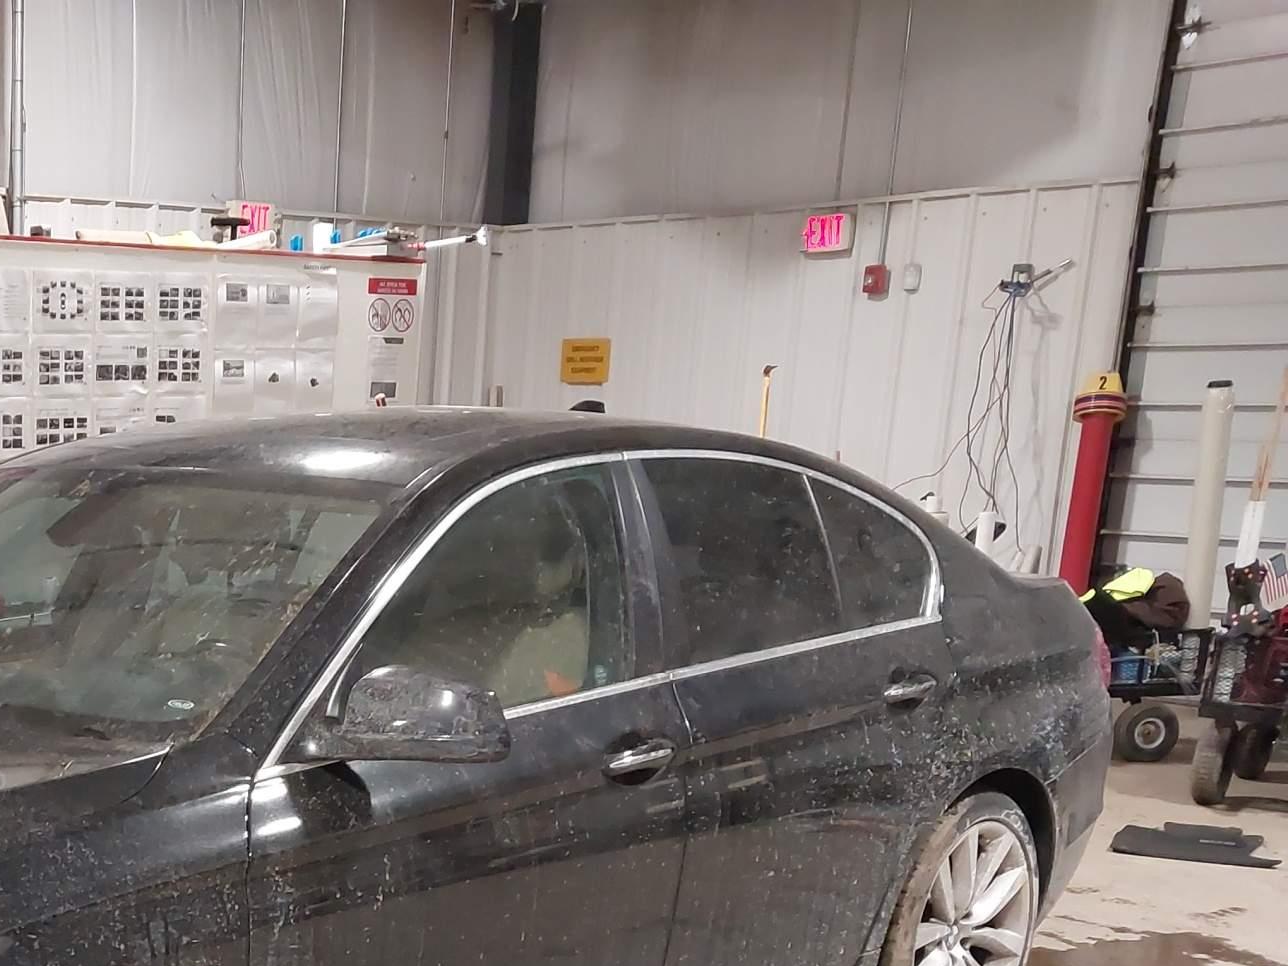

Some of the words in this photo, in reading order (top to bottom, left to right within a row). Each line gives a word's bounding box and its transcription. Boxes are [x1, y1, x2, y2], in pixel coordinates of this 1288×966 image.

[240, 204, 270, 233] EXIT
[808, 215, 844, 247] EXIT
[1099, 375, 1108, 390] 2
